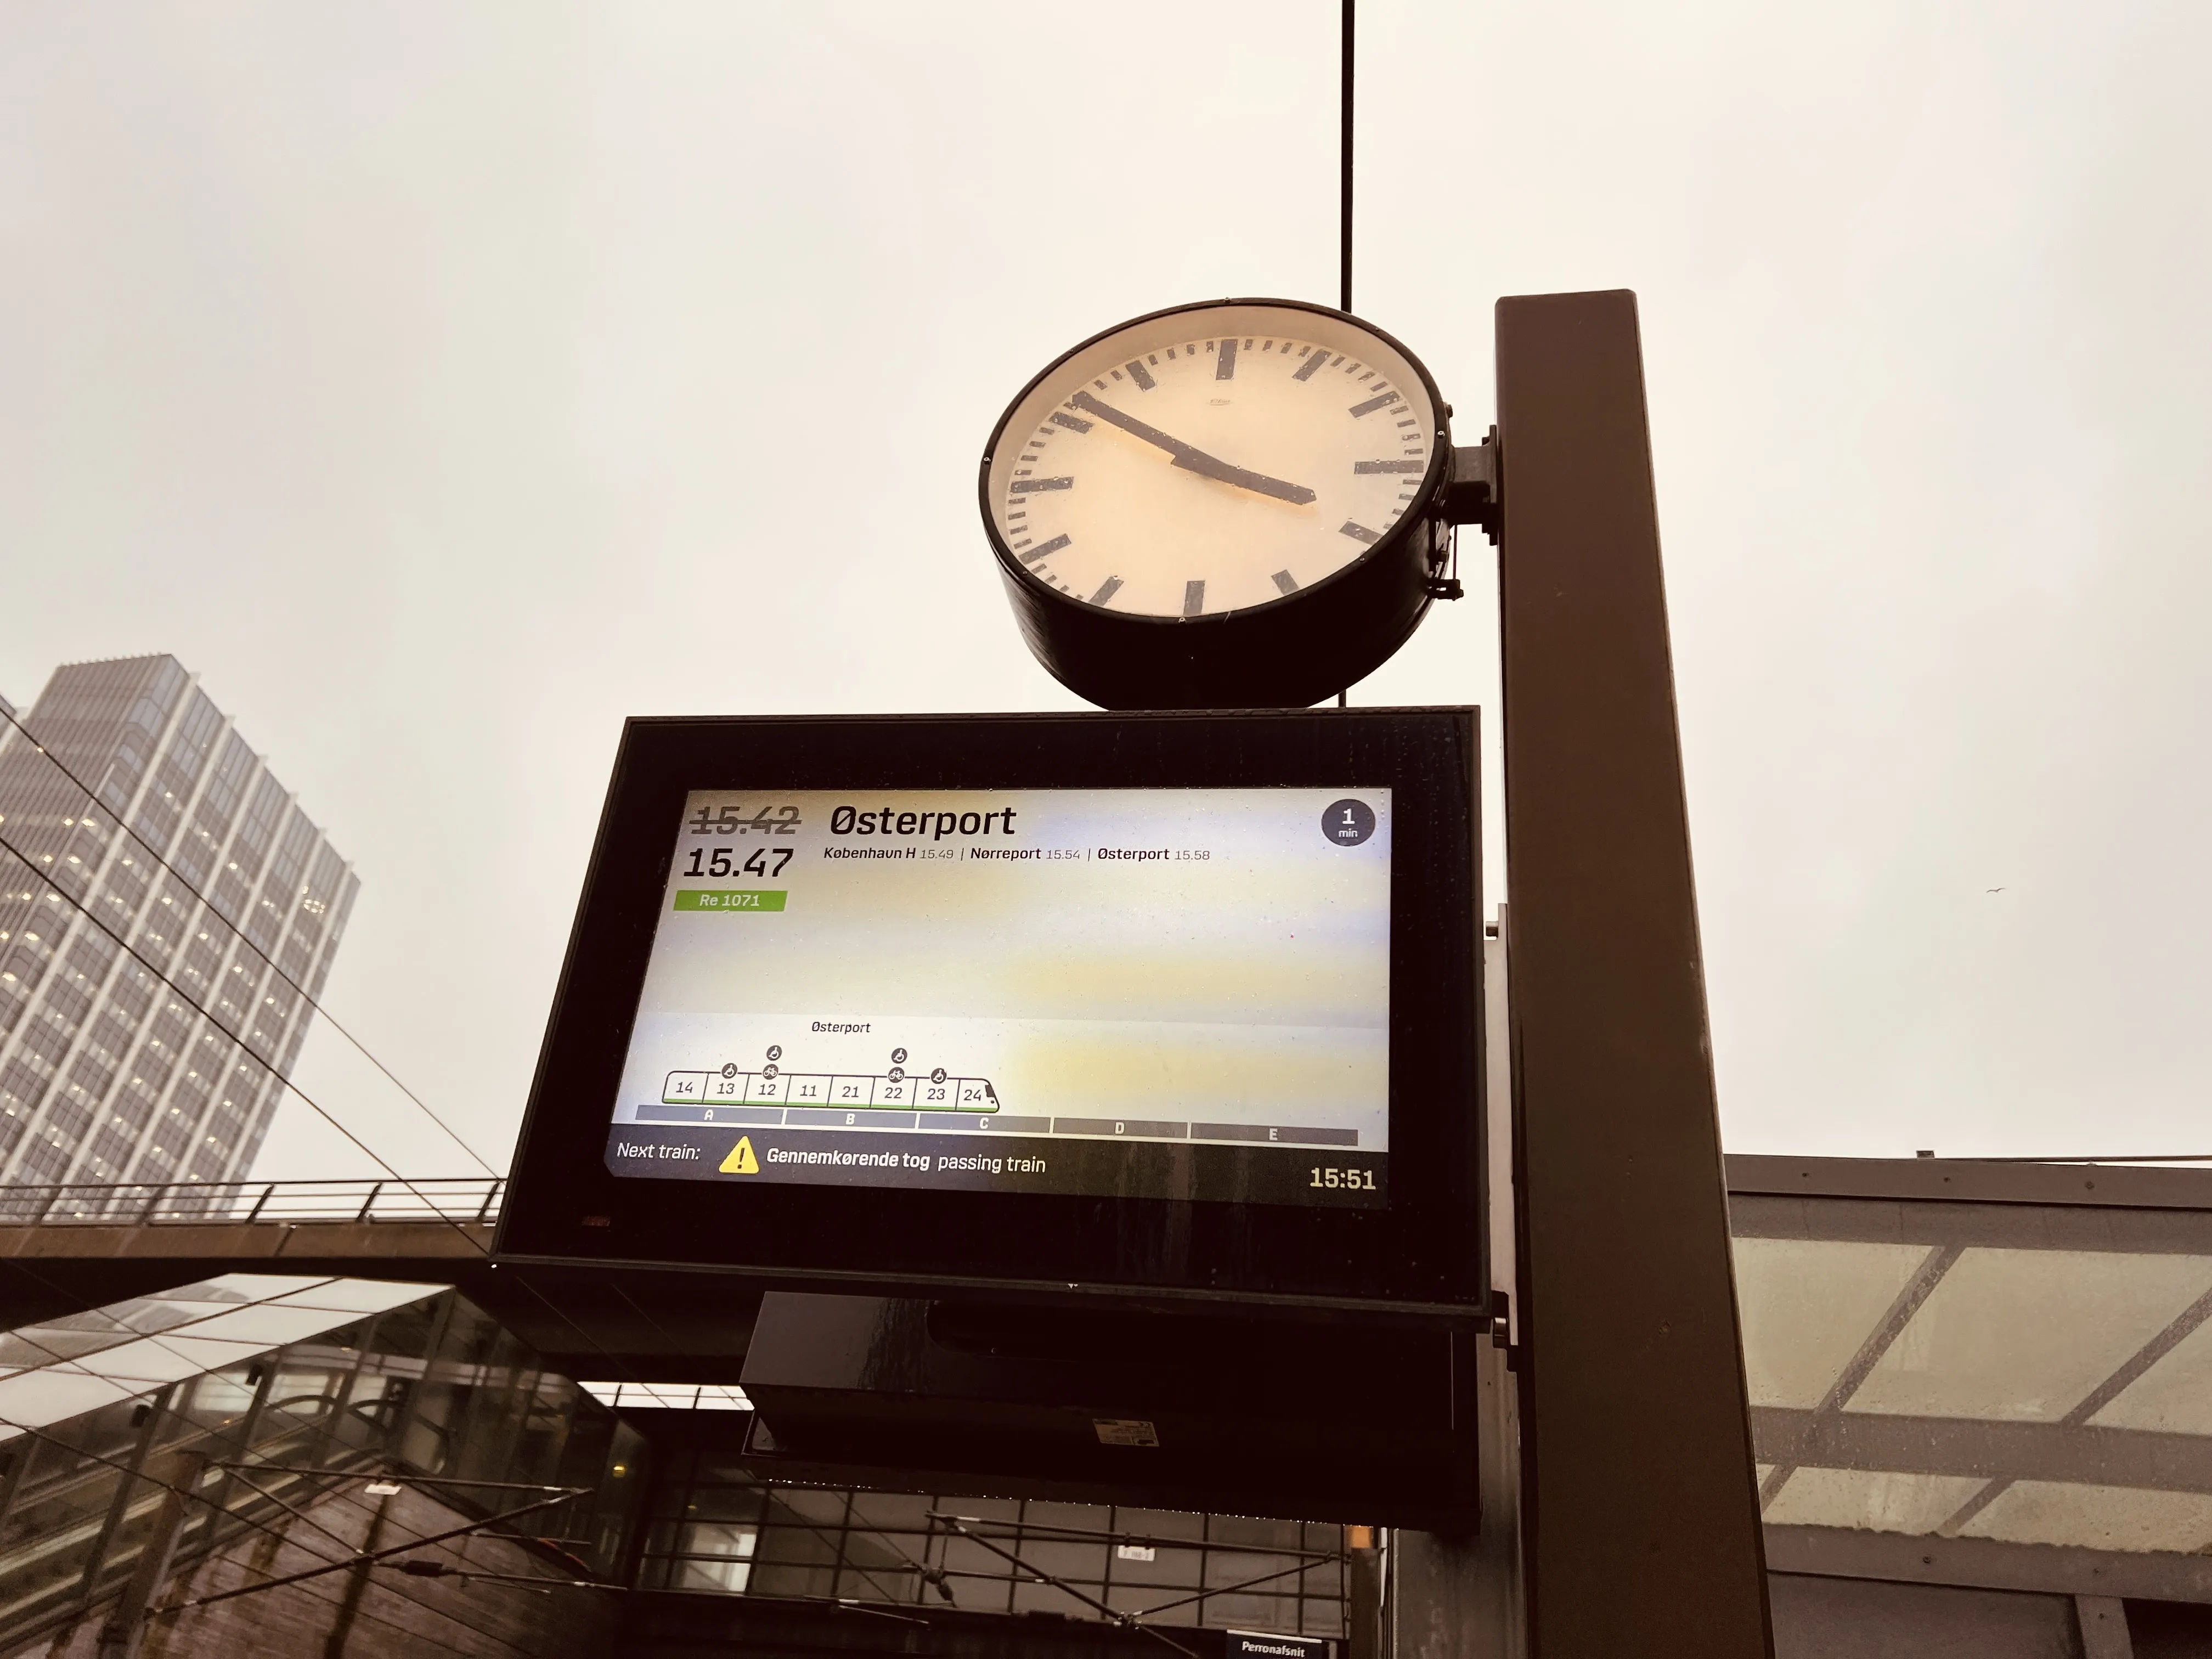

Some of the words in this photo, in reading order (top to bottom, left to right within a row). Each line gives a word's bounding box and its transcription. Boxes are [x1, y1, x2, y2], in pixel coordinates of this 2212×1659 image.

[690, 806, 801, 835] 15.42
[831, 805, 1017, 841] Østerport
[1342, 808, 1355, 825] 1
[1338, 828, 1358, 837] min
[683, 848, 794, 877] 15.47
[823, 847, 902, 859] København
[906, 847, 916, 859] H
[919, 849, 953, 859] 15.49
[970, 848, 1042, 861] Nørreport
[1046, 849, 1080, 860] 15.54
[1098, 848, 1170, 862] Østerport
[1175, 850, 1210, 860] 15.58
[699, 894, 718, 906] Re
[721, 894, 760, 906] 1071
[811, 1022, 871, 1035] Østerport
[675, 1081, 693, 1093] 14
[716, 1082, 735, 1094] 13
[758, 1084, 776, 1096] 12
[799, 1085, 817, 1097] 11
[842, 1086, 859, 1098] 21
[884, 1087, 902, 1099] 22
[927, 1088, 945, 1100] 23
[963, 1089, 981, 1102] 24
[703, 1109, 714, 1121] A
[845, 1113, 855, 1125] B
[979, 1117, 989, 1129] C
[1114, 1122, 1125, 1135] D
[1268, 1127, 1278, 1141] E
[617, 1142, 656, 1158] Next
[658, 1143, 701, 1160] train:
[767, 1148, 899, 1167] Gennemkørende
[902, 1153, 930, 1171] tog
[938, 1154, 1002, 1174] passing
[1006, 1155, 1046, 1173] train
[1310, 1167, 1376, 1190] 15:51
[1242, 1640, 1306, 1658] Perronafsnit
